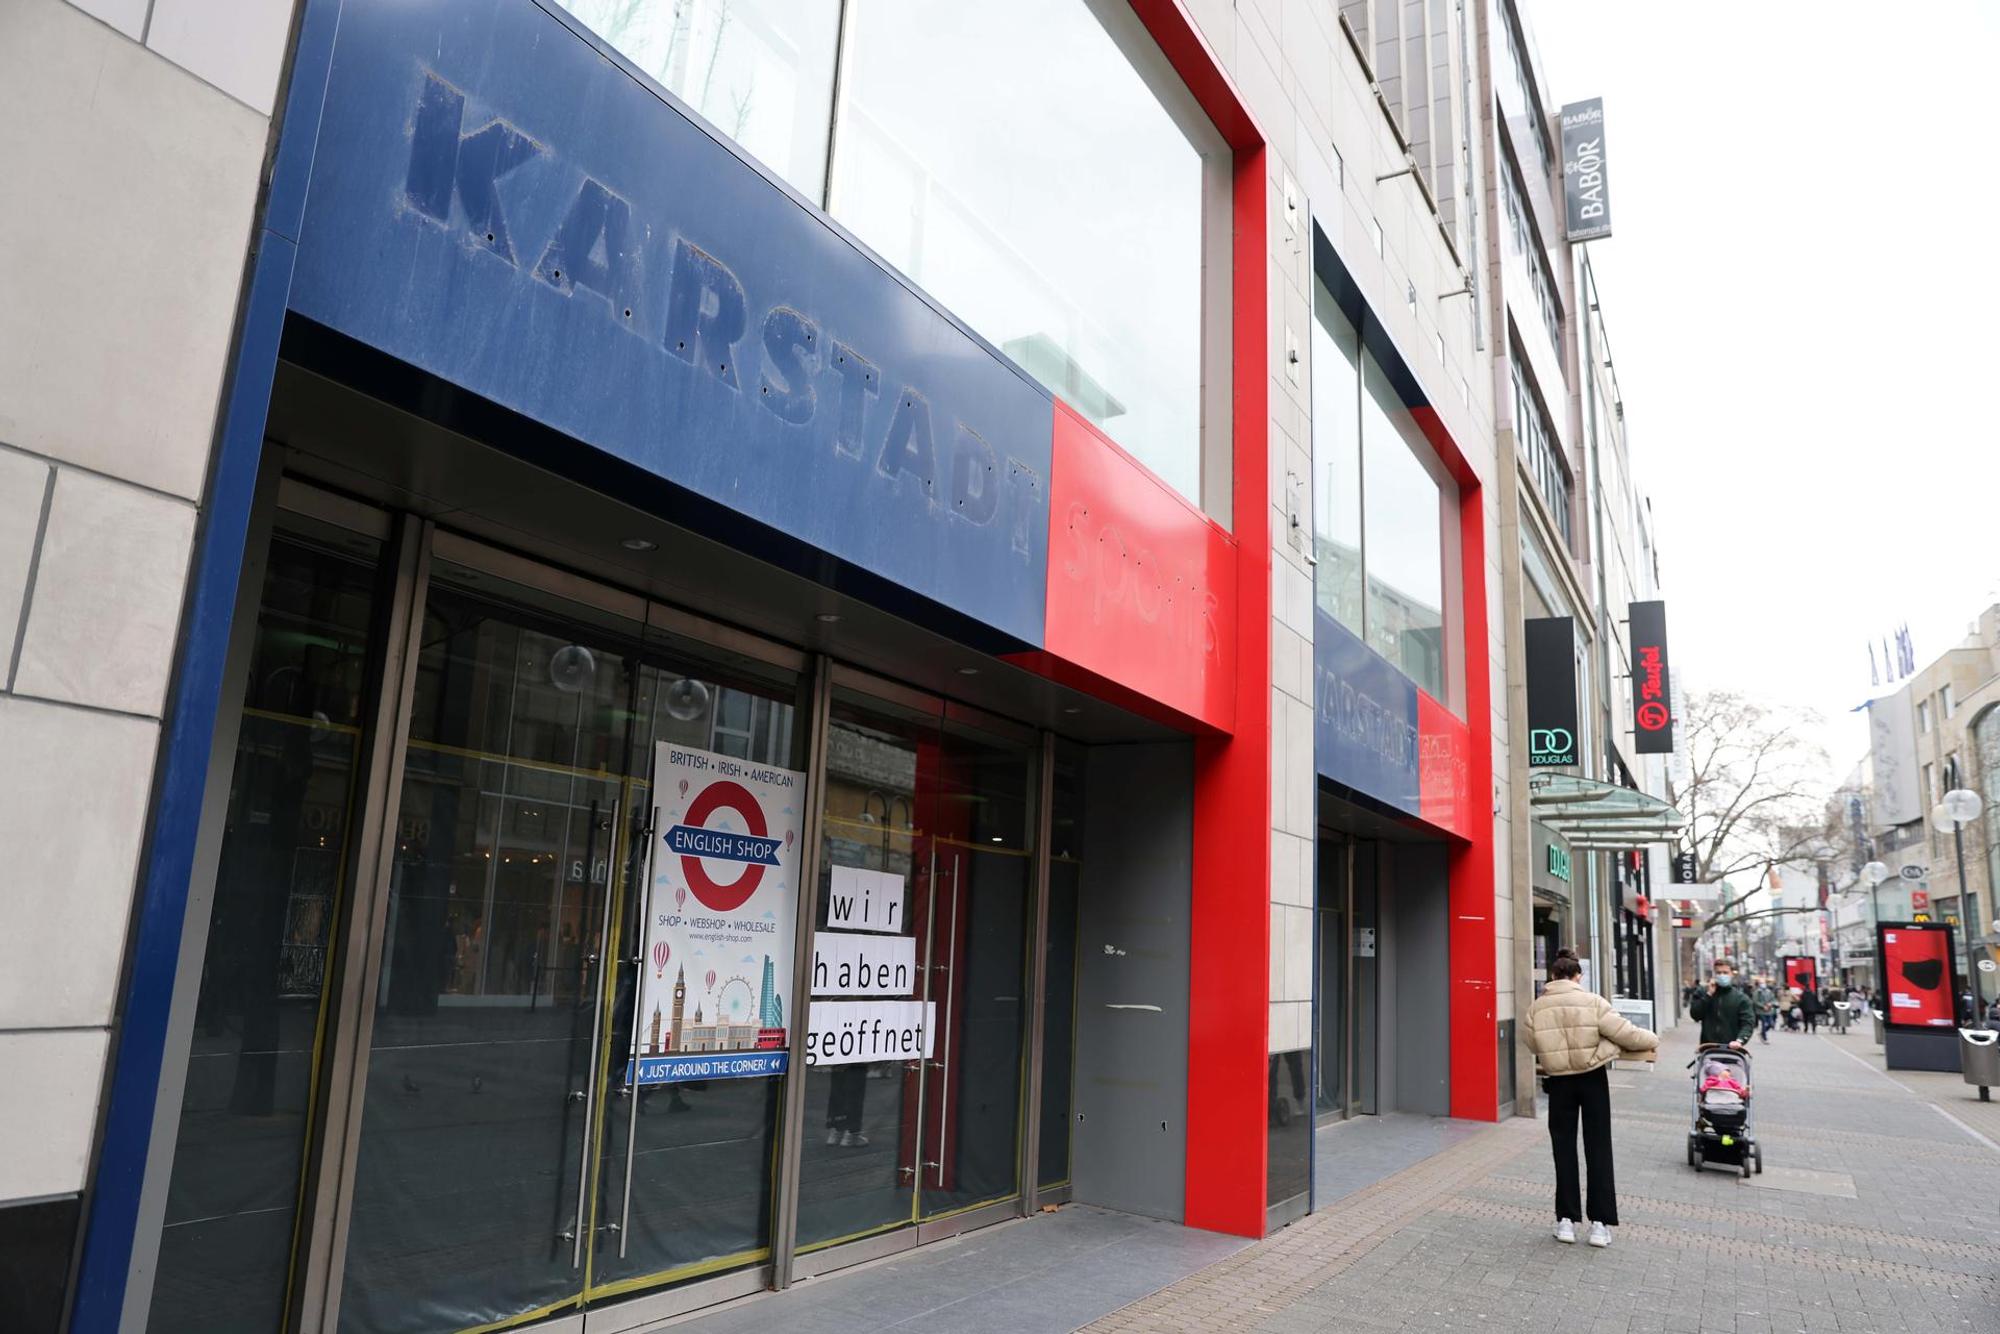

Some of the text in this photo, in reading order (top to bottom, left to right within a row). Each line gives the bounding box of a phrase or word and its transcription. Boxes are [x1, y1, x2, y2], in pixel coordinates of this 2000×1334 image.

[1577, 137, 1604, 220] BABOR
[402, 65, 1042, 559] KARSTADT
[1639, 646, 1663, 700] Teufel
[1317, 664, 1417, 776] ARSTADT
[670, 750, 794, 788] BRITISH IRISH AMERICAN
[675, 831, 772, 859] ENGLISH SHOP
[658, 914, 776, 933] SHOP WEBSHOP WHOLESALE
[833, 889, 898, 926] wir
[689, 932, 753, 943] www.english-shop.com
[813, 951, 908, 990] haben
[806, 1019, 922, 1066] geöffnet
[646, 1059, 767, 1079] JUST AROUND THE CORNER!
